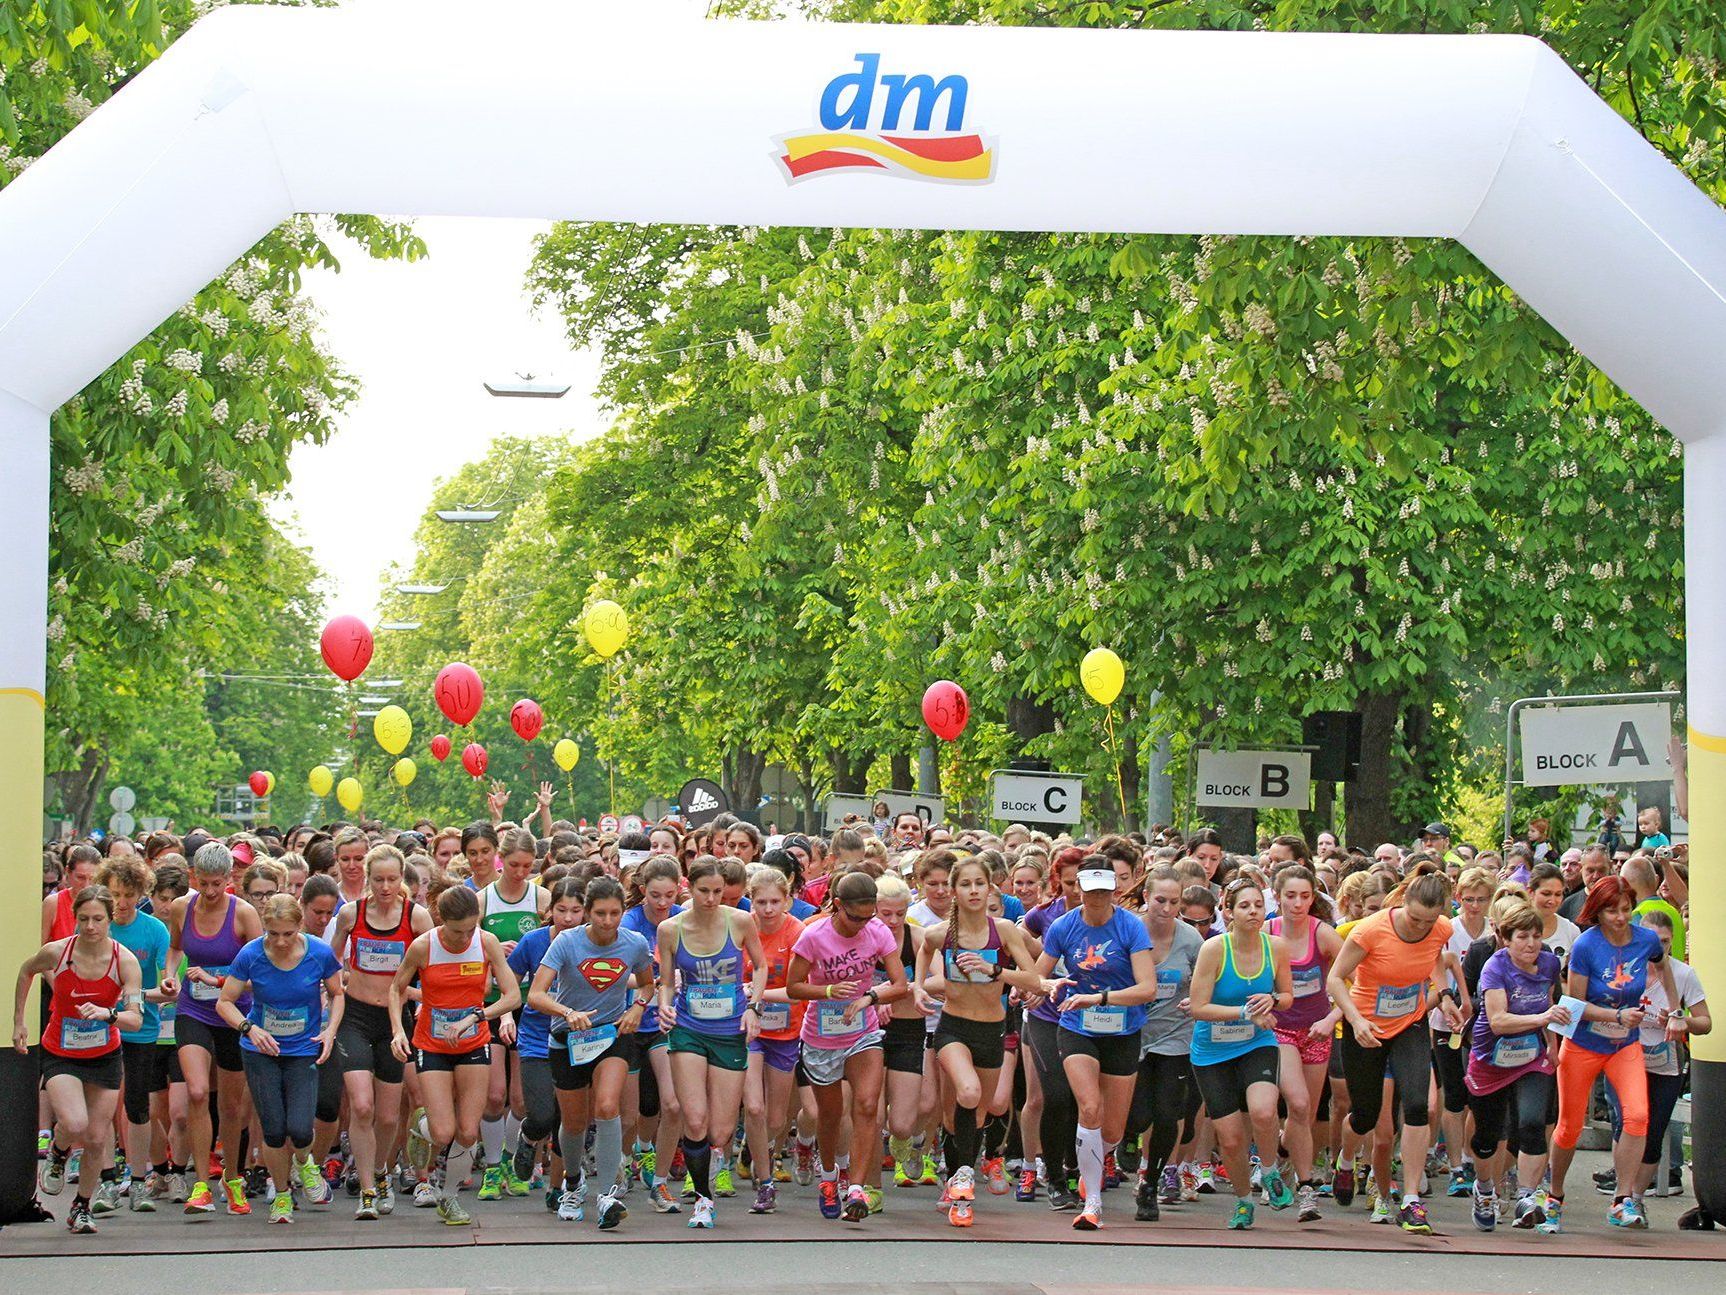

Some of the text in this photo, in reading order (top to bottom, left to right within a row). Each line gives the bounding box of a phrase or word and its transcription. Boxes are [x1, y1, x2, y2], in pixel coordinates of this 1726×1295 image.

[819, 53, 968, 131] dm
[1537, 721, 1650, 769] BLOCK A
[1205, 763, 1290, 797] BLOCK B
[1001, 786, 1068, 813] BLOCK C
[823, 948, 860, 970] MAKE
[824, 969, 836, 981] IT
[1093, 1015, 1113, 1023] Heidi
